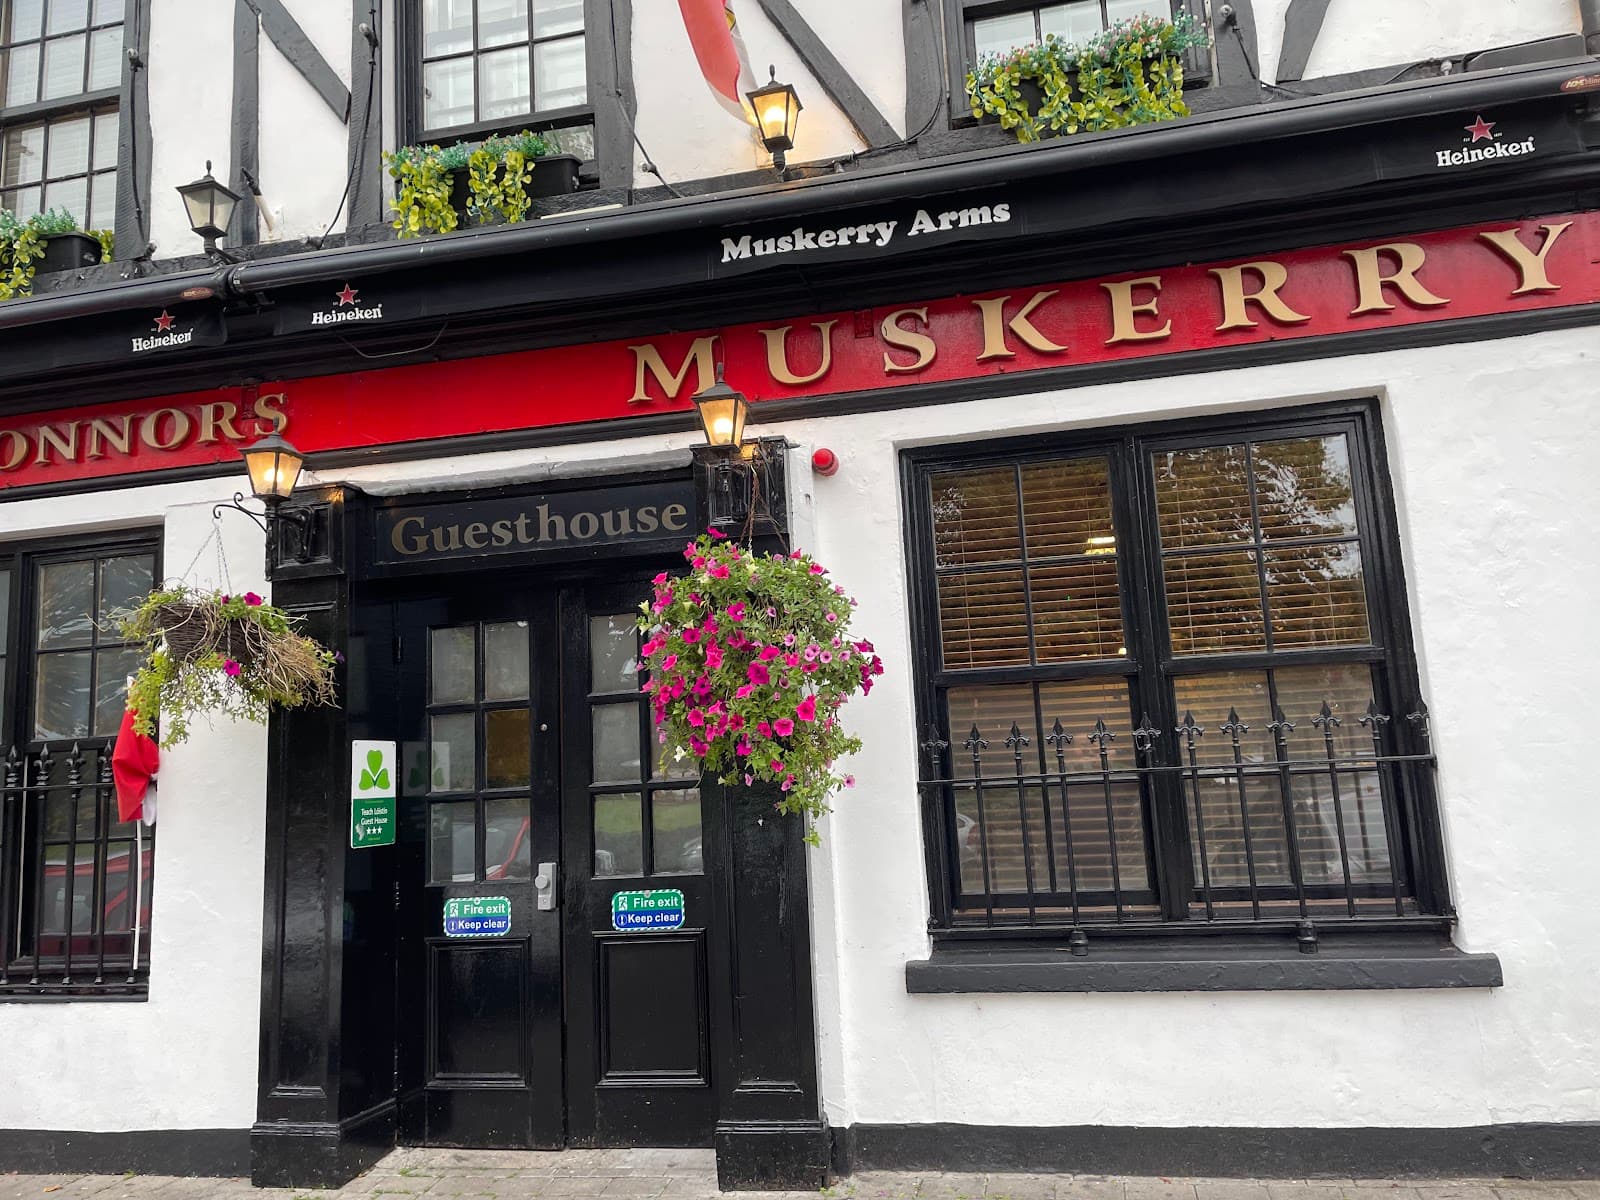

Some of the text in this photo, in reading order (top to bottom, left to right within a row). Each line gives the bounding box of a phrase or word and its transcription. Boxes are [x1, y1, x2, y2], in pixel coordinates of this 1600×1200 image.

[1435, 140, 1536, 167] Heineken
[720, 203, 1011, 263] Muskerry Arms
[311, 304, 383, 326] Heineken
[627, 220, 1574, 404] MUSKERRY
[131, 329, 193, 352] Heineken
[390, 502, 689, 556] Guesthouse
[463, 903, 506, 915] Fire exit
[633, 896, 679, 908] Fire exit
[458, 918, 506, 931] Keep clear
[627, 912, 680, 925] Keep clear
